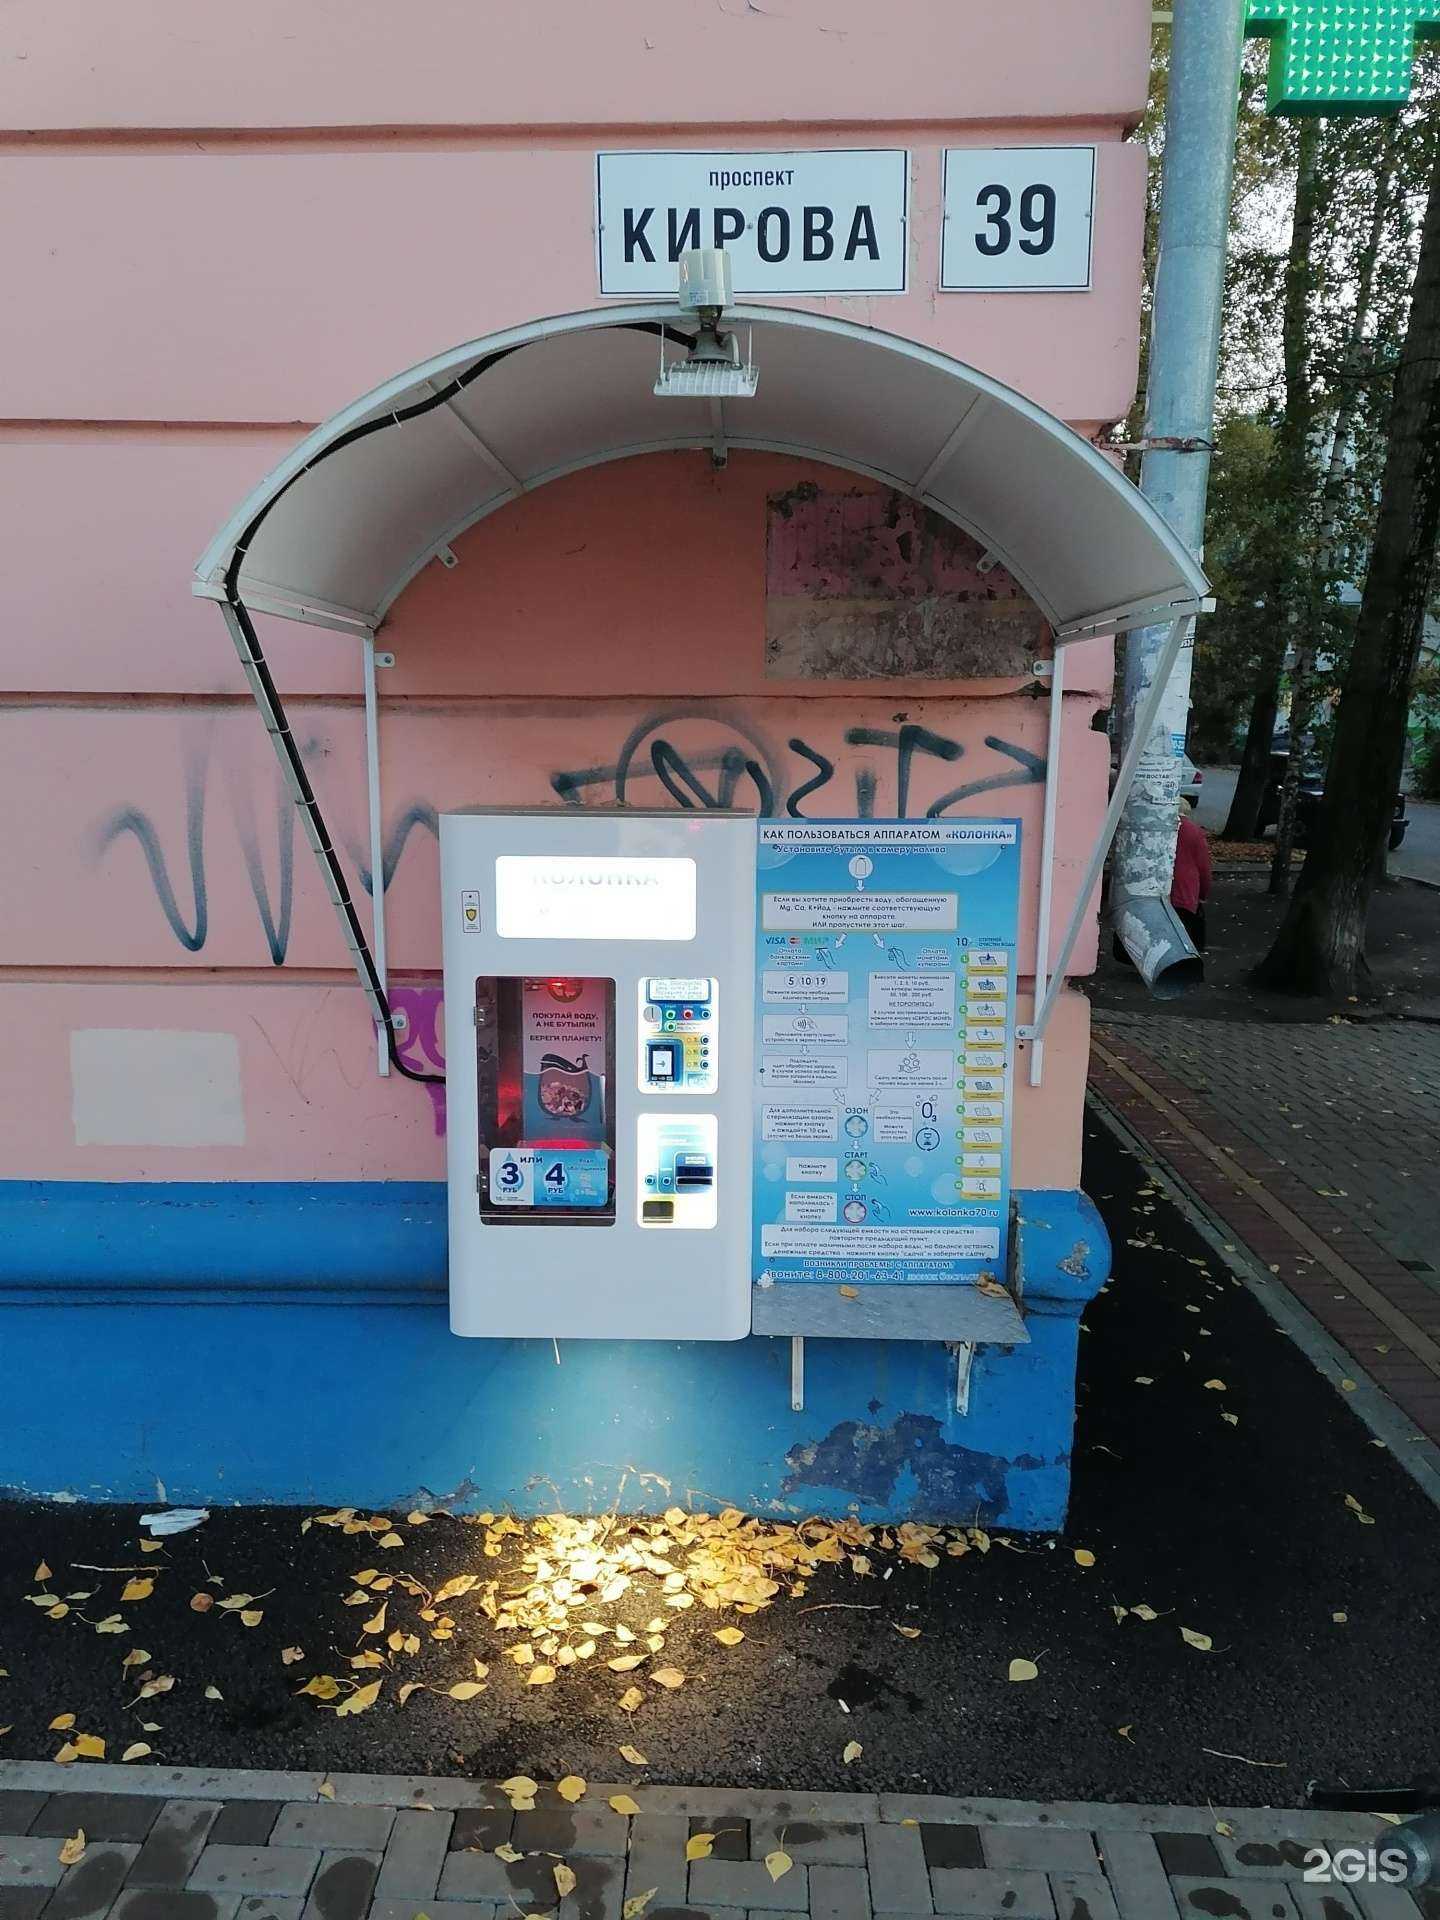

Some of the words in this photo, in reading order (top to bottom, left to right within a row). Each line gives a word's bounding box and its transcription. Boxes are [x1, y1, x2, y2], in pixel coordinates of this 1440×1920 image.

[708, 168, 795, 191] проспект
[974, 183, 1057, 256] 39
[623, 204, 881, 263] КИРОВА
[763, 829, 785, 840] КАК
[787, 829, 871, 840] ПОЛЬЗОВАТЬСЯ
[873, 829, 941, 840] АППАРАТОМ
[945, 829, 1012, 840] «КОЛОНКА»
[776, 845, 831, 855] Установите
[876, 845, 911, 855] камеру
[913, 845, 946, 855] налива
[765, 937, 786, 945] VISA
[956, 937, 968, 947] 10
[788, 976, 794, 986] 5
[801, 976, 812, 986] 10
[815, 976, 826, 986] 19
[532, 1011, 573, 1020] ПОКУПАЙ
[529, 1034, 560, 1042] БЕРЕГИ
[561, 1034, 602, 1042] ПЛАНЕТУ!
[845, 1106, 869, 1114] ОЗОН
[500, 1162, 520, 1185] 3
[545, 1162, 566, 1186] 4
[816, 1270, 904, 1280] 8-800-201-63-41
